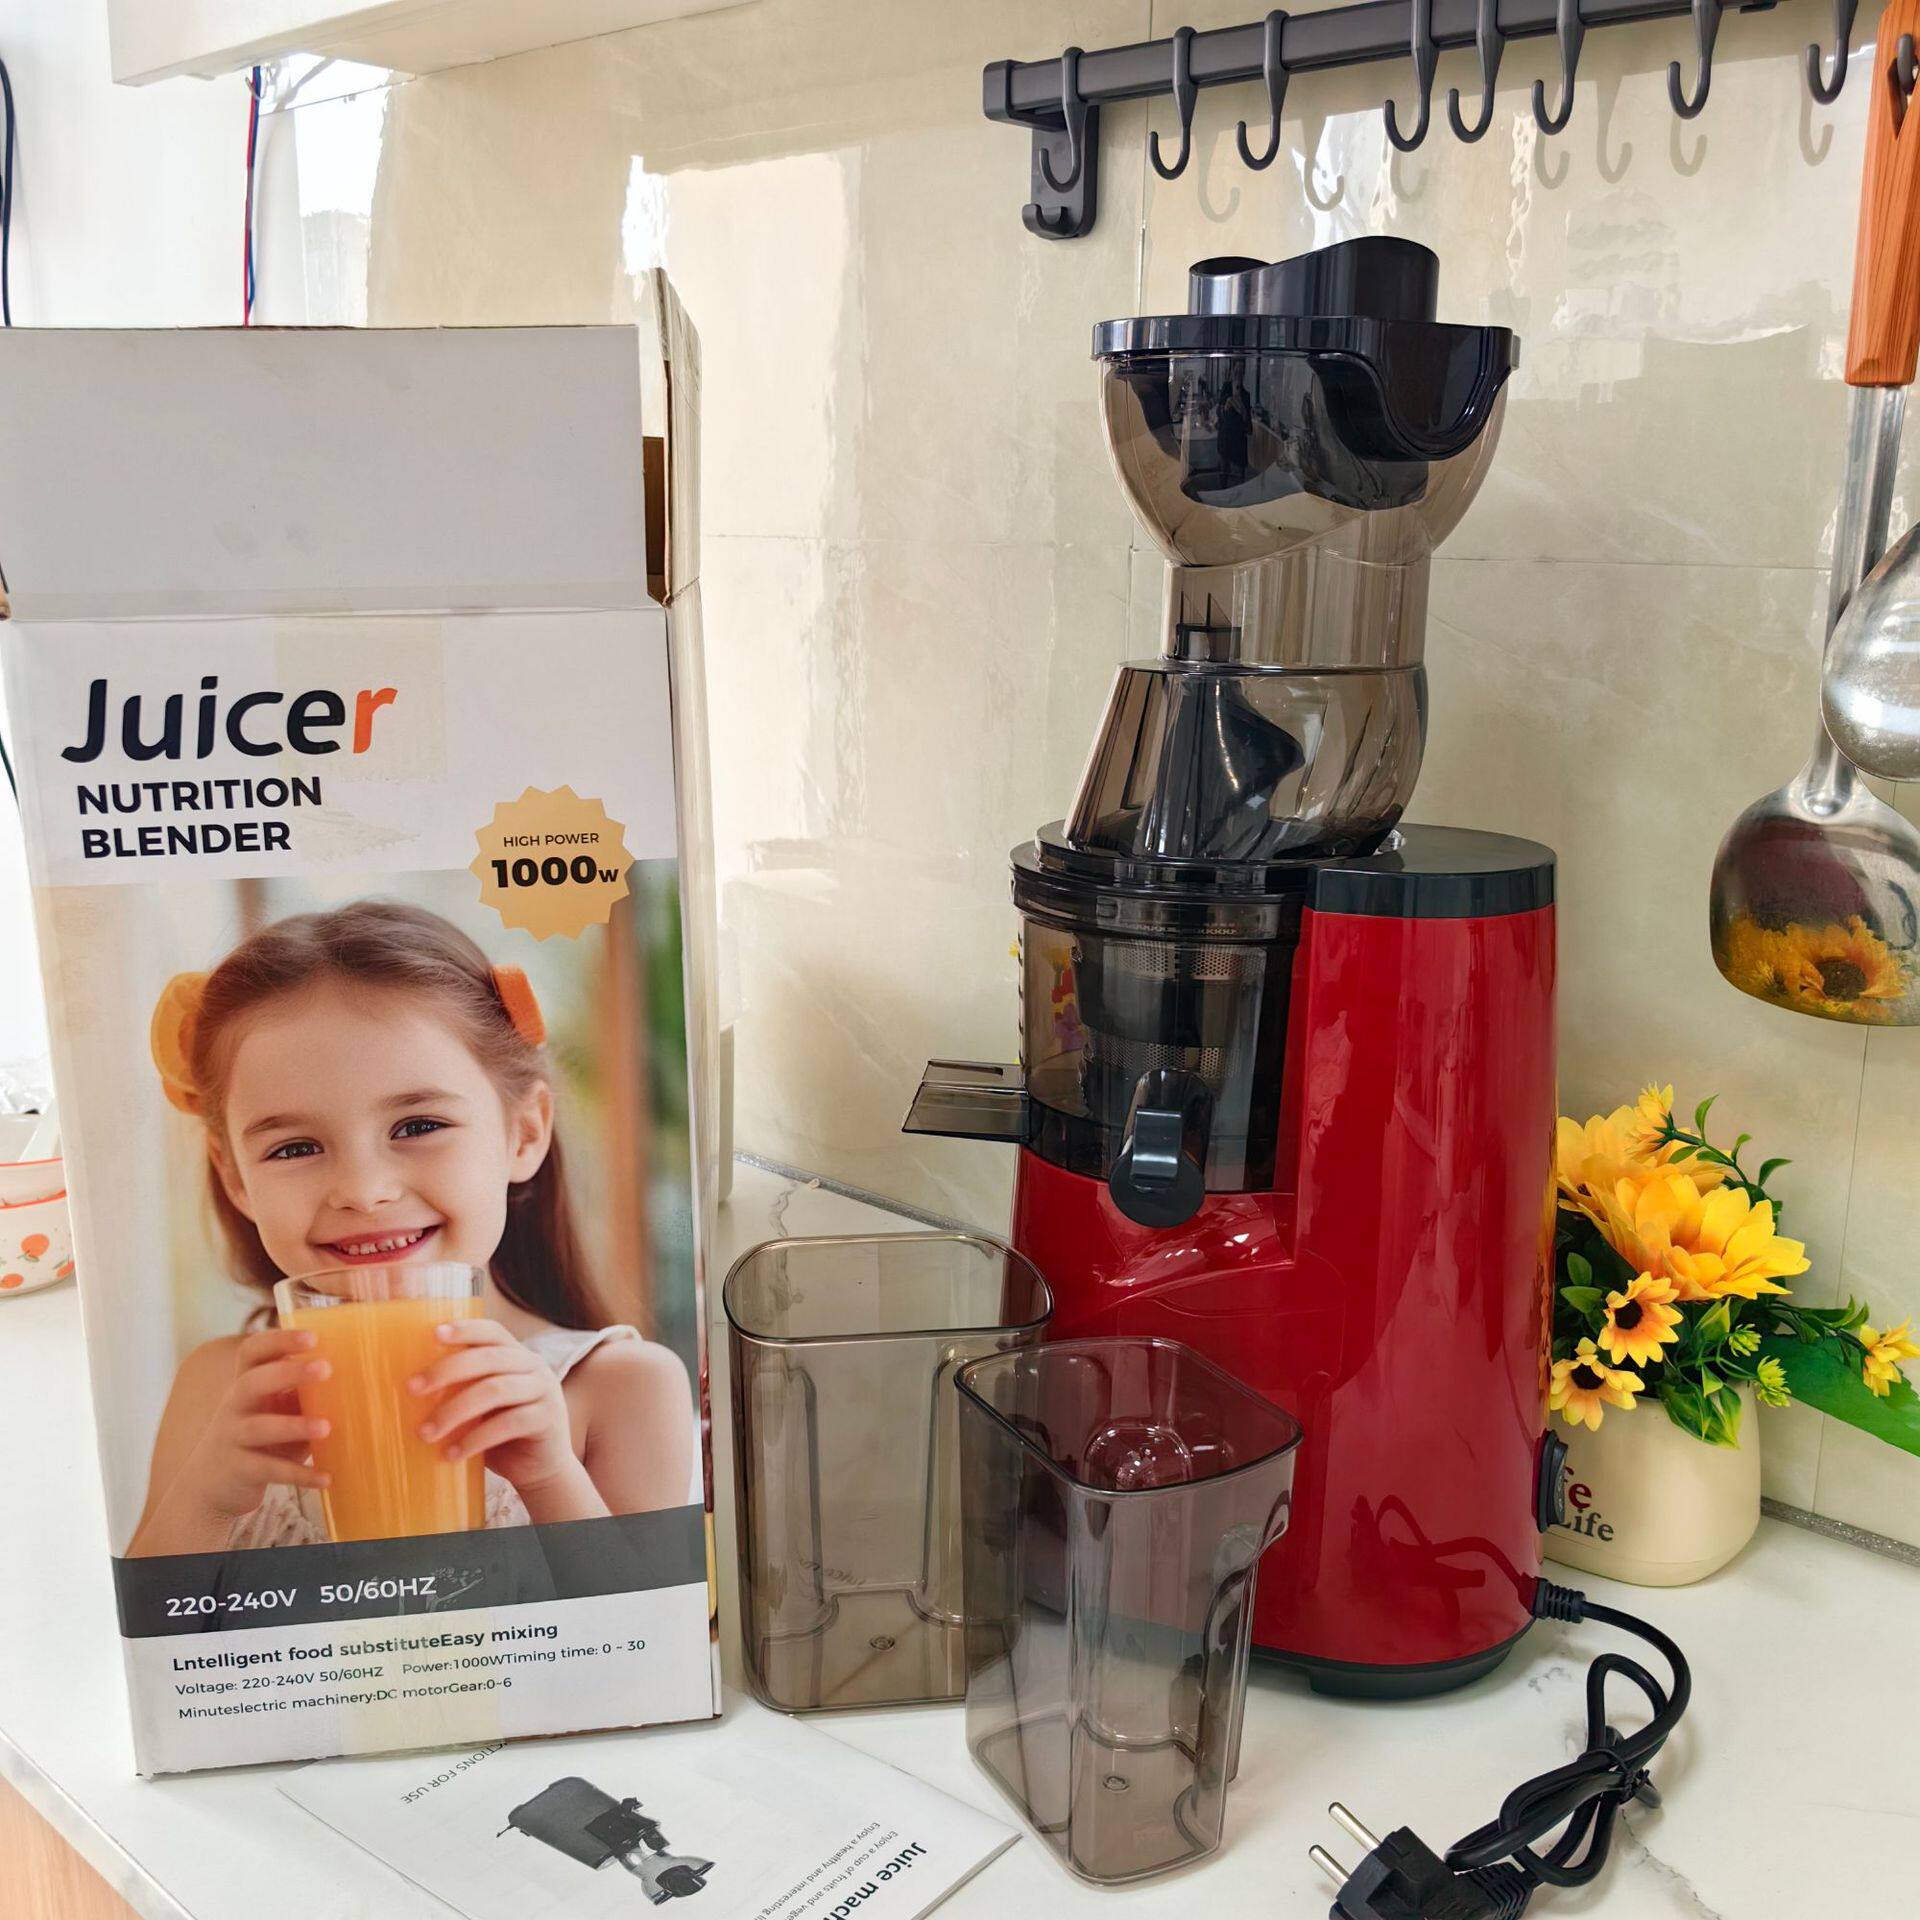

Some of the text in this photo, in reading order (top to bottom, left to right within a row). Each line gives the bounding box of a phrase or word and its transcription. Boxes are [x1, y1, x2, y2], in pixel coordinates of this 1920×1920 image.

[60, 675, 398, 763] Juicer
[77, 776, 322, 815] NUTRITION
[82, 821, 291, 858] BLENDER
[503, 832, 600, 848] HIGH POWER
[165, 1575, 437, 1617] 220-240V 50/60HZ
[172, 1649, 282, 1671] Lntelligent
[288, 1644, 333, 1661] food
[491, 1624, 558, 1642] mixing
[175, 1681, 238, 1696] Voltage:
[242, 1672, 315, 1690] 220-240V
[319, 1666, 384, 1683] 50/60HZ
[561, 1644, 598, 1658] time:
[627, 1640, 645, 1651] 30
[179, 1699, 287, 1719] Minuteslectric
[428, 1769, 457, 1788] FOR
[400, 1786, 430, 1804] USE
[857, 1822, 880, 1840] Enjoy
[874, 1830, 898, 1850] Enjoy
[822, 1843, 854, 1869] healthy
[854, 1853, 870, 1867] cup
[876, 1842, 927, 1881] Juice
[806, 1867, 823, 1883] and
[823, 1872, 848, 1892] fruits
[762, 1880, 807, 1915] interesting
[807, 1890, 824, 1906] and
